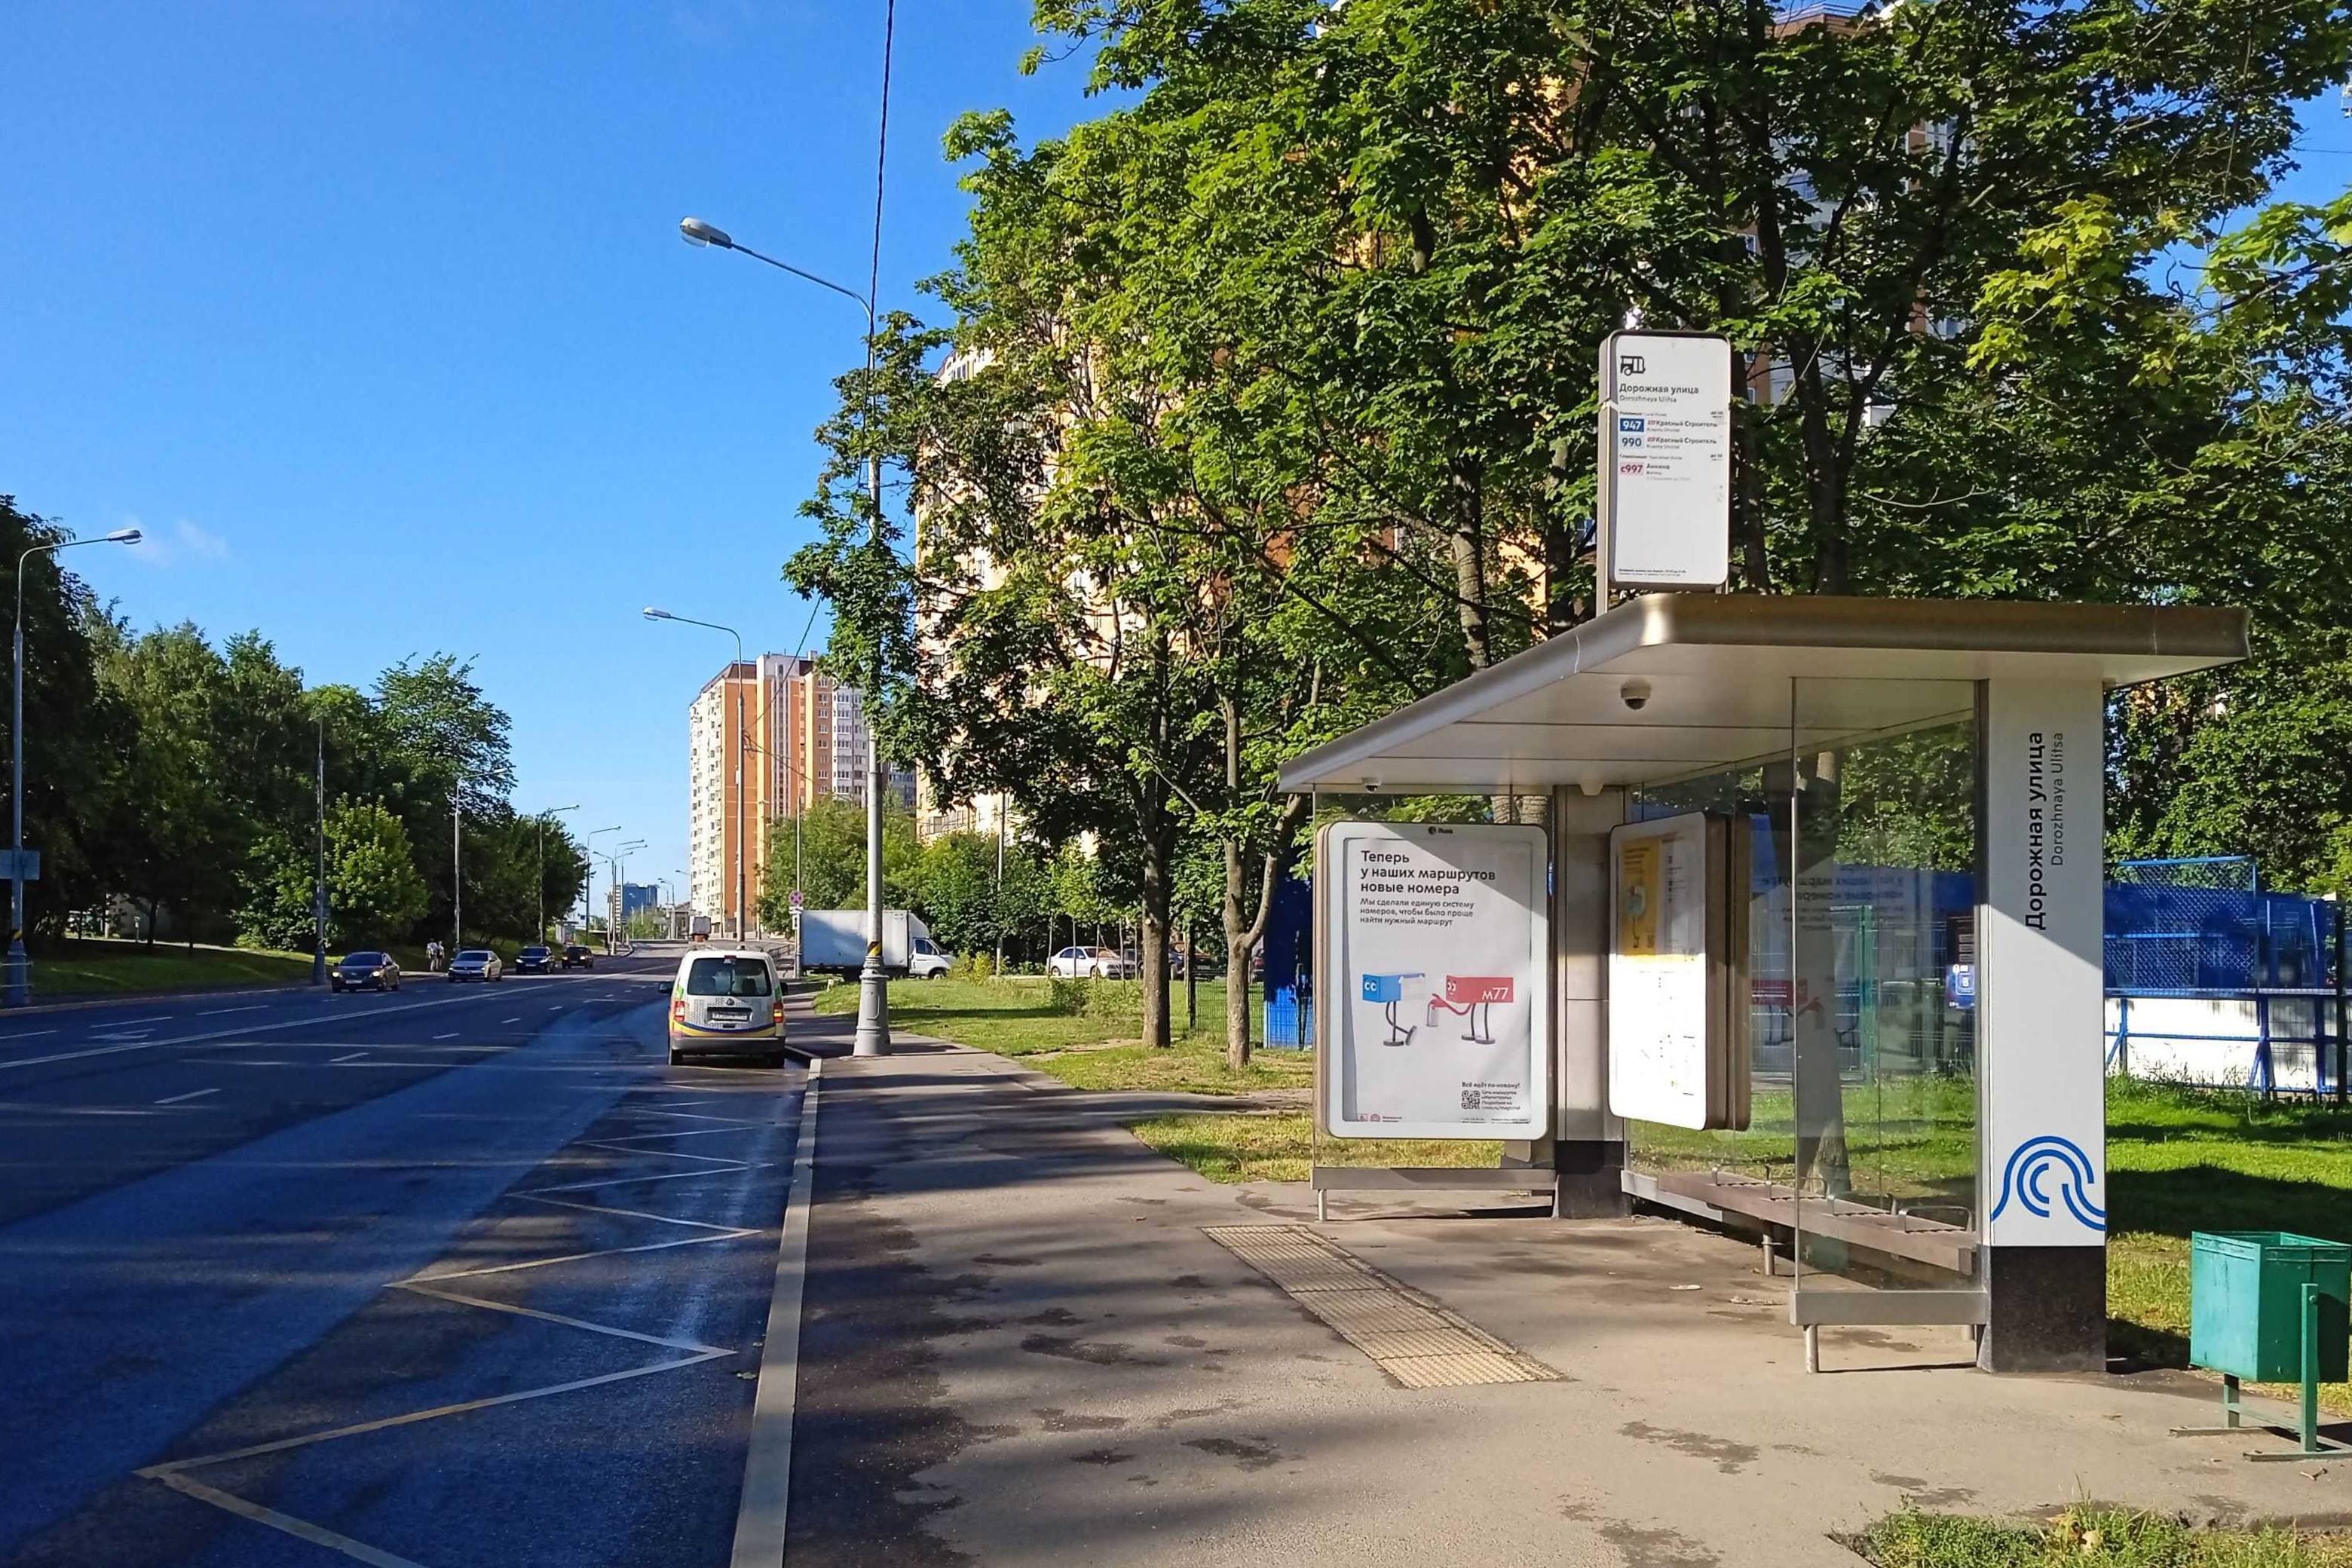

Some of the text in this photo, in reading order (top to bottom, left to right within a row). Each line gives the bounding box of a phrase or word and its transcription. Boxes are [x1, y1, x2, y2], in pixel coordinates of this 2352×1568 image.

[1619, 383, 1699, 395] Дорожная улица
[1622, 421, 1642, 430] 947
[1622, 437, 1642, 447] 990
[2050, 733, 2066, 865] Dorozhnaya Ulitsa
[2025, 732, 2047, 930] Дорожная улица
[1361, 850, 1410, 865] Теперь
[1360, 868, 1496, 883] у наших маршрутов
[1361, 883, 1459, 896] новые номера
[1377, 899, 1409, 907] сделали
[1410, 900, 1441, 908] единую
[1442, 901, 1475, 909] систему
[1398, 908, 1423, 916] чтобы
[1384, 917, 1416, 925] нужный
[1416, 917, 1453, 926] маршрут
